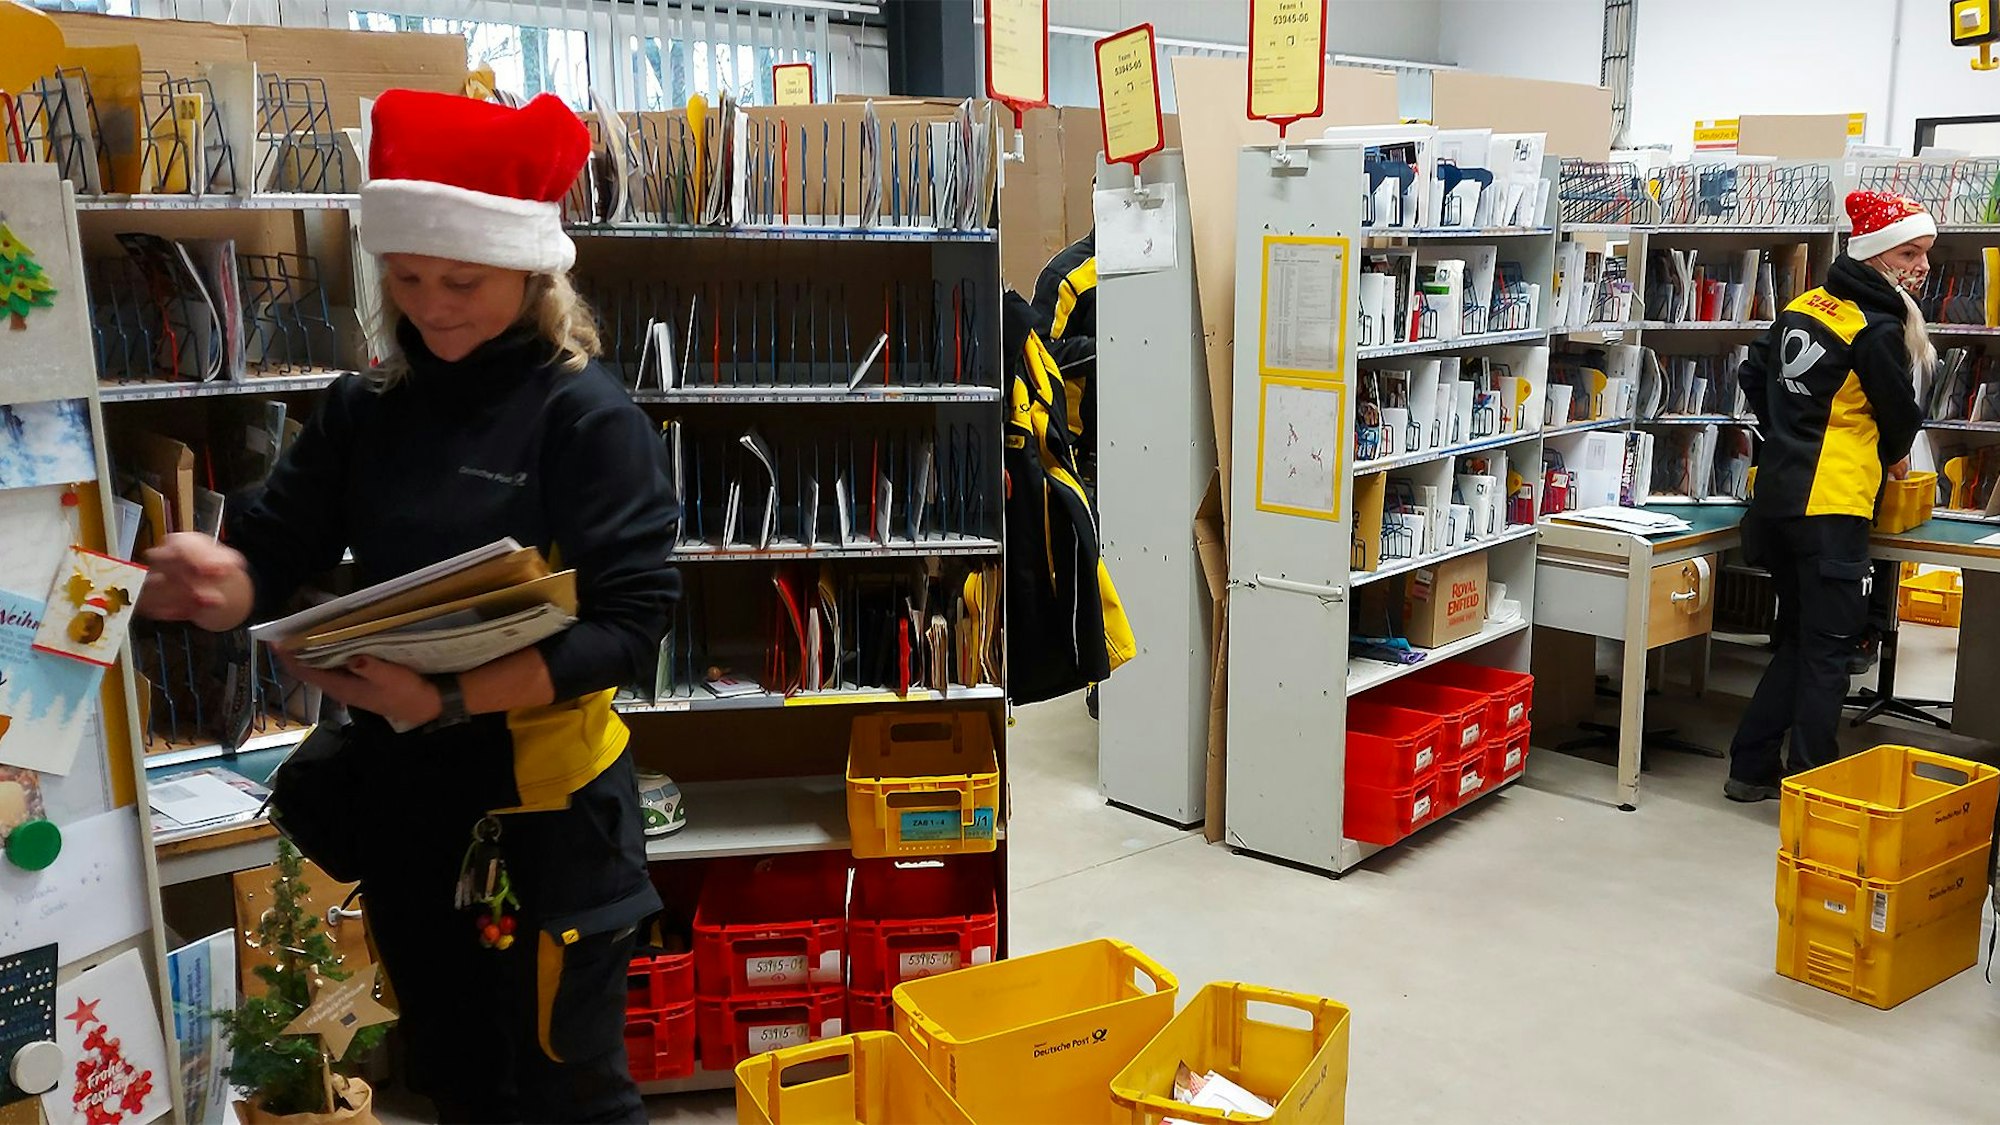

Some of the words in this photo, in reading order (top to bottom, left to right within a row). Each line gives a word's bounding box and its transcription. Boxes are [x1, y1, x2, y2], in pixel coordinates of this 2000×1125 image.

[1279, 3, 1297, 11] Team
[1806, 295, 1840, 317] DHL
[1451, 580, 1478, 599] ROYAL
[1446, 593, 1479, 617] ENFIELD
[1033, 1042, 1071, 1058] Deutsche
[1072, 1036, 1089, 1048] Post
[86, 1060, 124, 1090] Frohe
